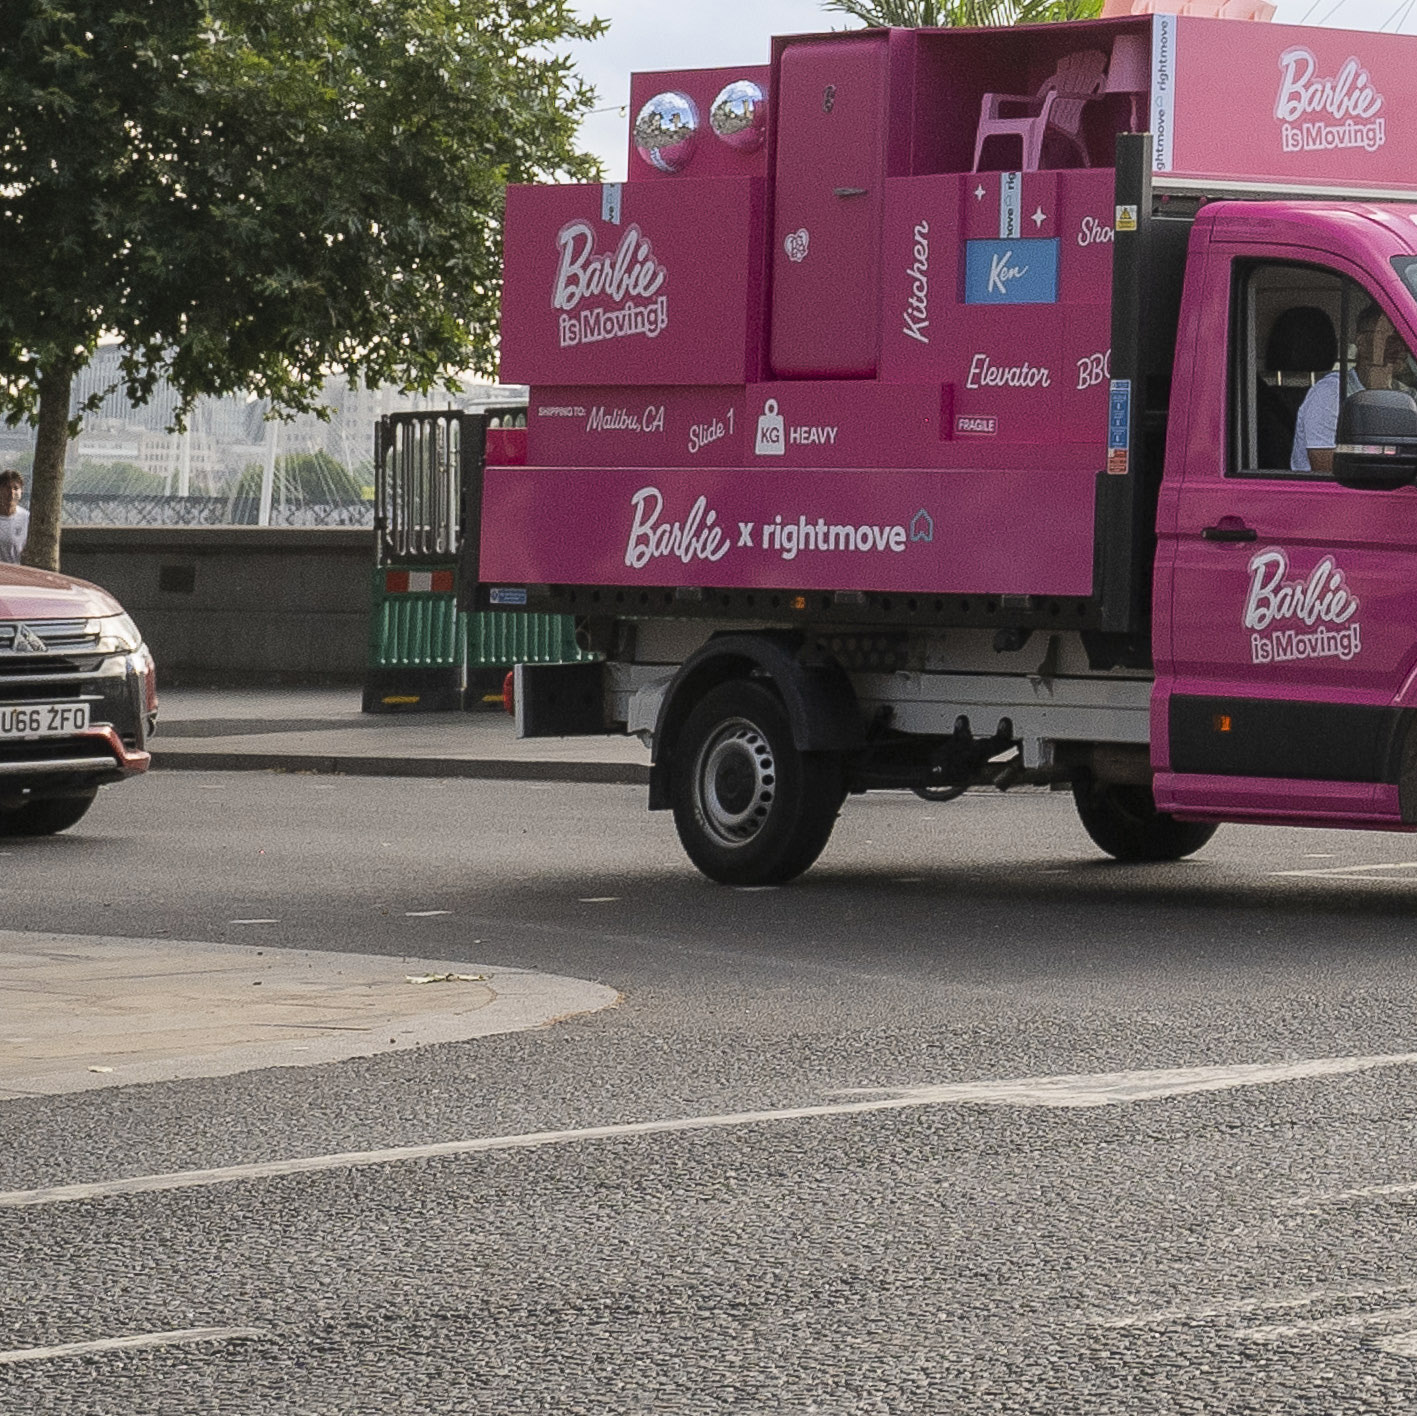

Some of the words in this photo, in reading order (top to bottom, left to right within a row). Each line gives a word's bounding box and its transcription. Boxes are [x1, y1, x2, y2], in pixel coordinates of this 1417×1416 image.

[1157, 20, 1170, 91] rightmove
[1276, 49, 1383, 122] Barbie
[1282, 124, 1302, 152] is
[1303, 118, 1385, 152] Moving!
[553, 223, 668, 310] Barbie
[902, 219, 930, 344] Kitchen
[987, 250, 1029, 294] Ken
[560, 314, 580, 347] is
[580, 296, 668, 344] Moving!
[965, 353, 1051, 389] Elevator
[538, 406, 573, 417] SHIPPING
[688, 418, 726, 454] Slide
[726, 407, 735, 435] 1
[957, 418, 995, 433] FRAGILE
[760, 426, 780, 444] KG
[789, 426, 838, 445] HEAVY
[624, 485, 731, 569] Barbie
[737, 522, 754, 547] x
[762, 514, 907, 561] rightmove
[1245, 551, 1358, 630] Barbie
[1251, 633, 1272, 664] is
[1272, 623, 1361, 662] Moving!
[47, 707, 86, 731] ZFO
